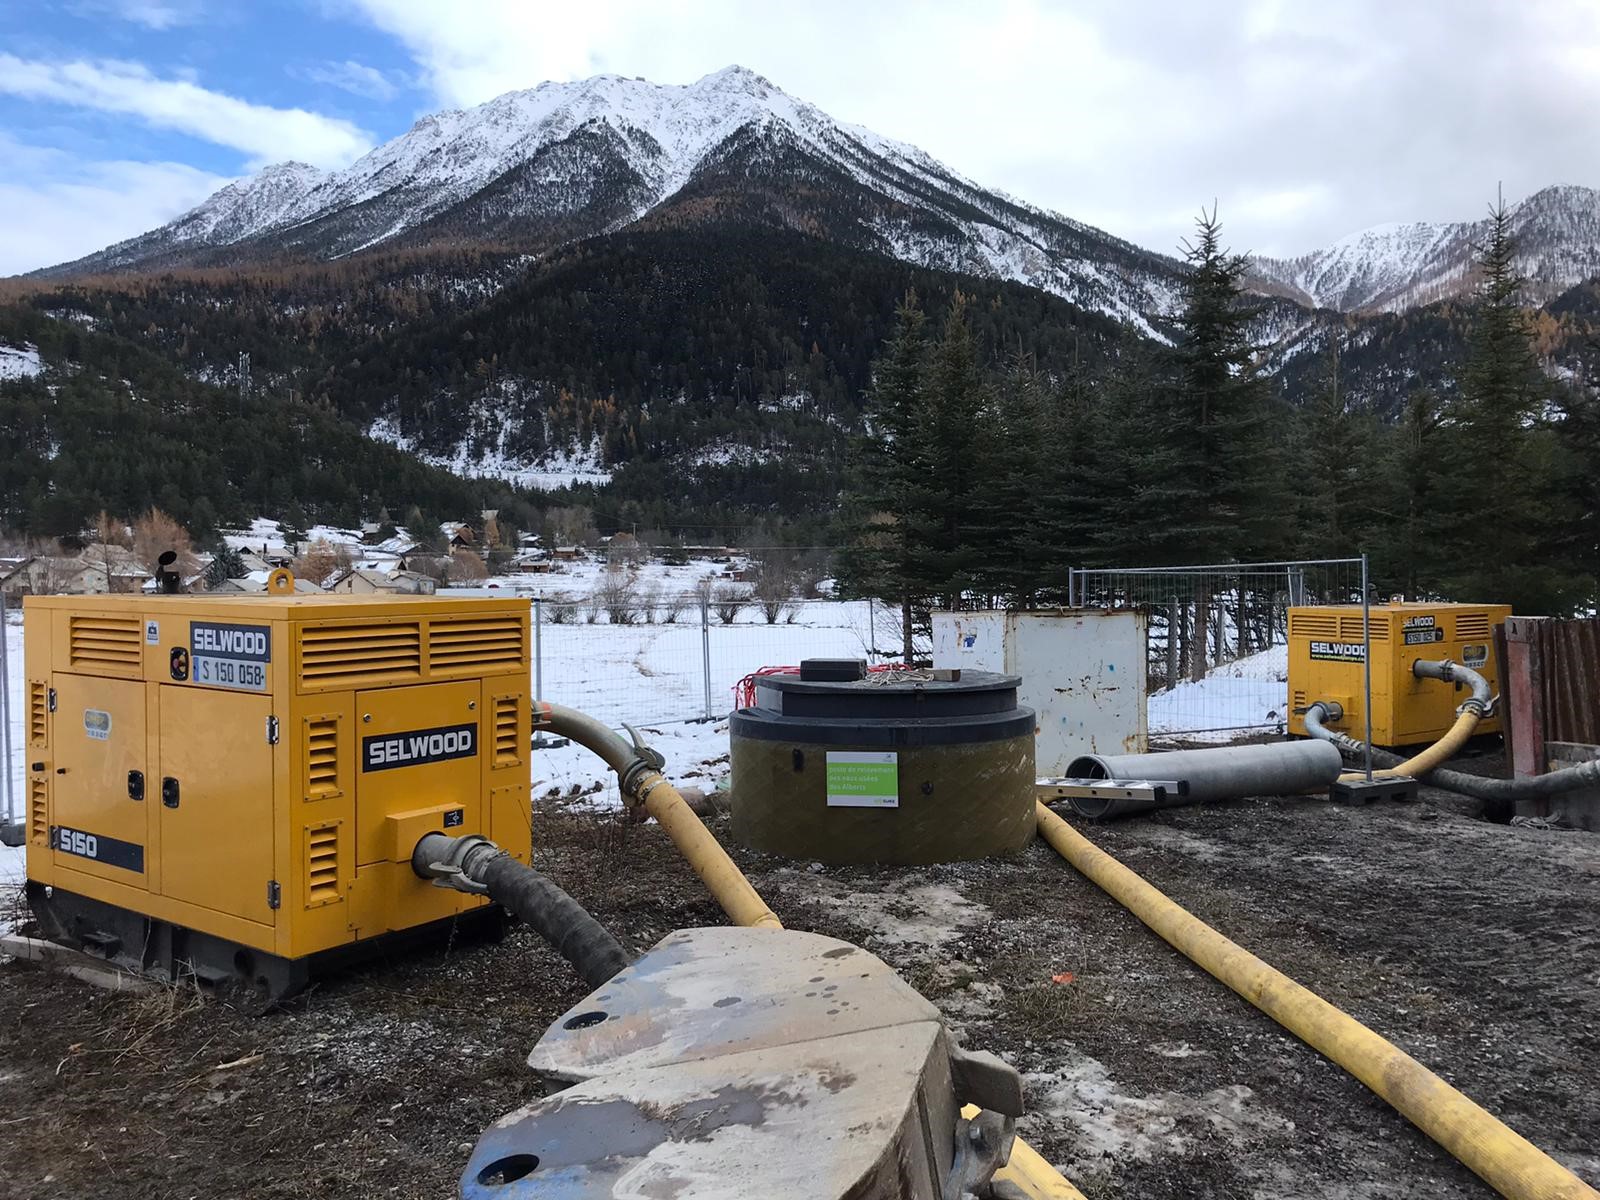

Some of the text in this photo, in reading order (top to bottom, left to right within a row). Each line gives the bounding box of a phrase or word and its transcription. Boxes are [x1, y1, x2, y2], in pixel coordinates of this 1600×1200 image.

[194, 628, 266, 655] SELWOOD
[202, 660, 262, 686] S 150 058
[369, 730, 472, 765] SELWOOD
[60, 829, 97, 858] S150
